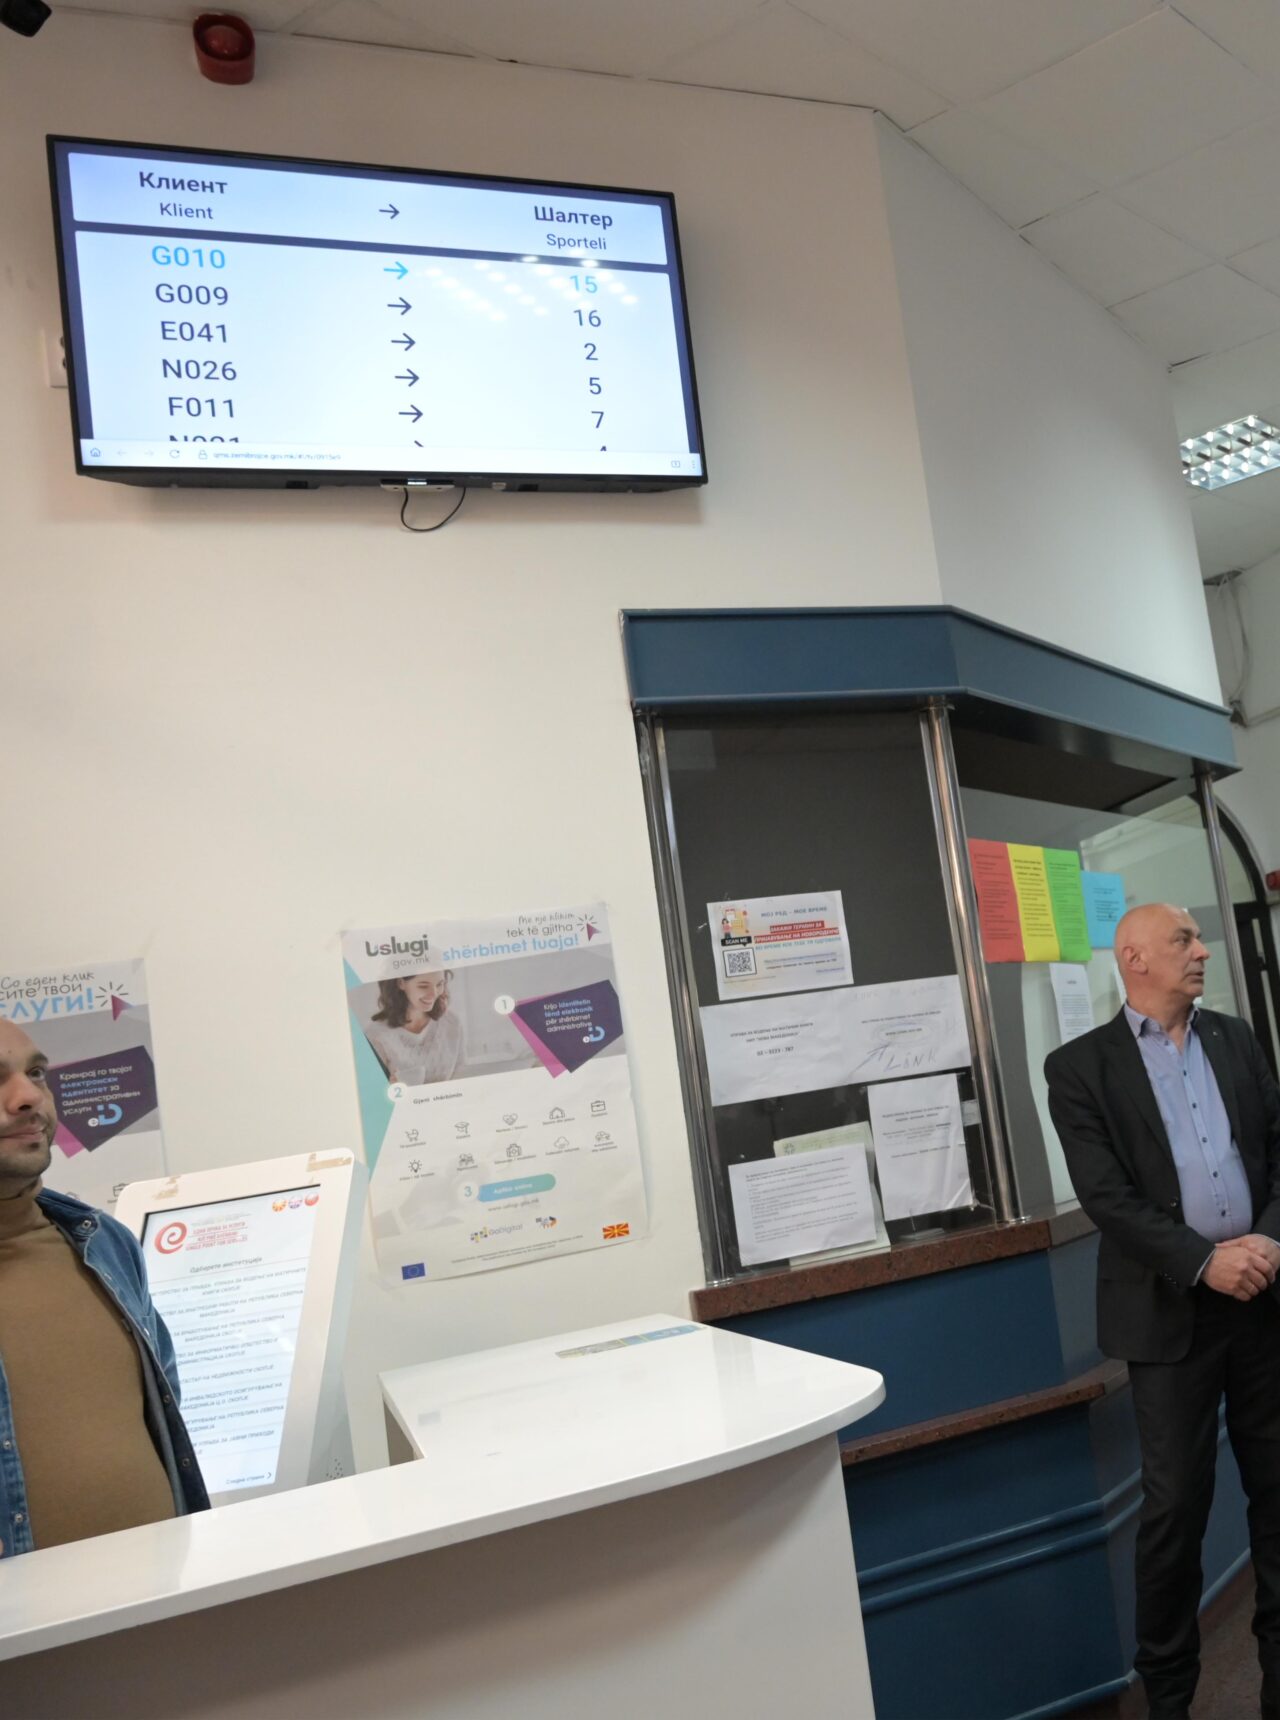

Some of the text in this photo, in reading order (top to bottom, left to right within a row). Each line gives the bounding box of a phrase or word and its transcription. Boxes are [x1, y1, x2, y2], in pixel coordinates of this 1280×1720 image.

[139, 171, 228, 195] Клиент
[159, 202, 214, 220] Klient
[534, 205, 613, 230] Шалтер
[546, 233, 607, 251] Sporteli
[152, 245, 599, 295] G010 15
[155, 283, 602, 328] G009 16
[160, 320, 599, 362] E041 2
[162, 358, 602, 396] N026 5
[168, 396, 605, 430] F011 7
[506, 922, 573, 938] tek të gjitha
[442, 934, 580, 961] shërbimet tuaja!
[392, 956, 430, 970] gov.mk
[63, 971, 95, 984] клик
[44, 983, 83, 996] твои
[501, 999, 508, 1010] 1
[97, 1068, 107, 1076] го
[108, 1065, 133, 1075] твојот
[393, 1087, 403, 1099] 2
[464, 1186, 473, 1198] 3
